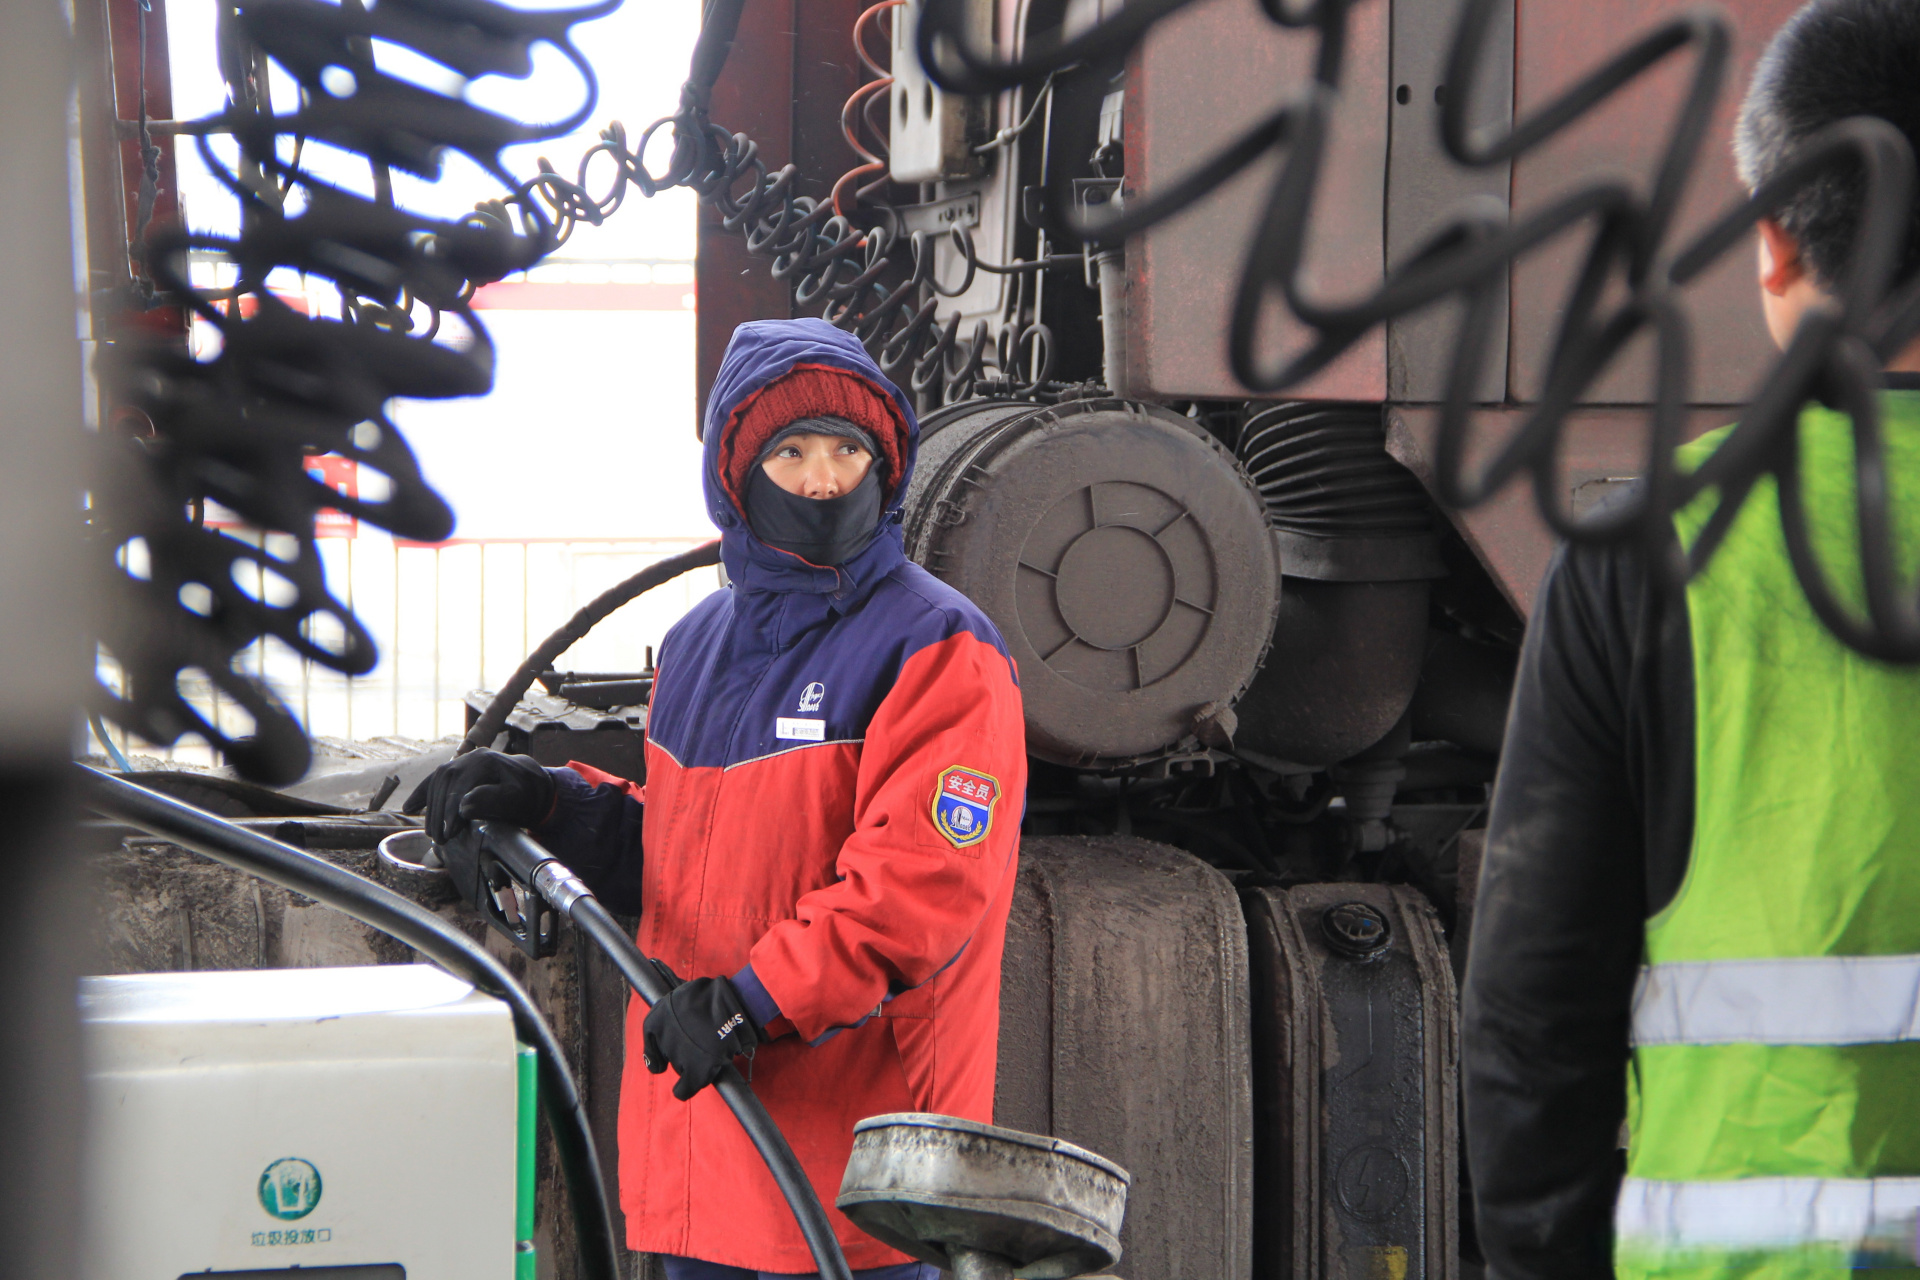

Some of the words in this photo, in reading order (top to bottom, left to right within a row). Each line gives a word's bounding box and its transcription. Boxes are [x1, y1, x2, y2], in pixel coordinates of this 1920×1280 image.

[948, 775, 990, 800] 安全员
[251, 1228, 331, 1246] 垃圾投放口
